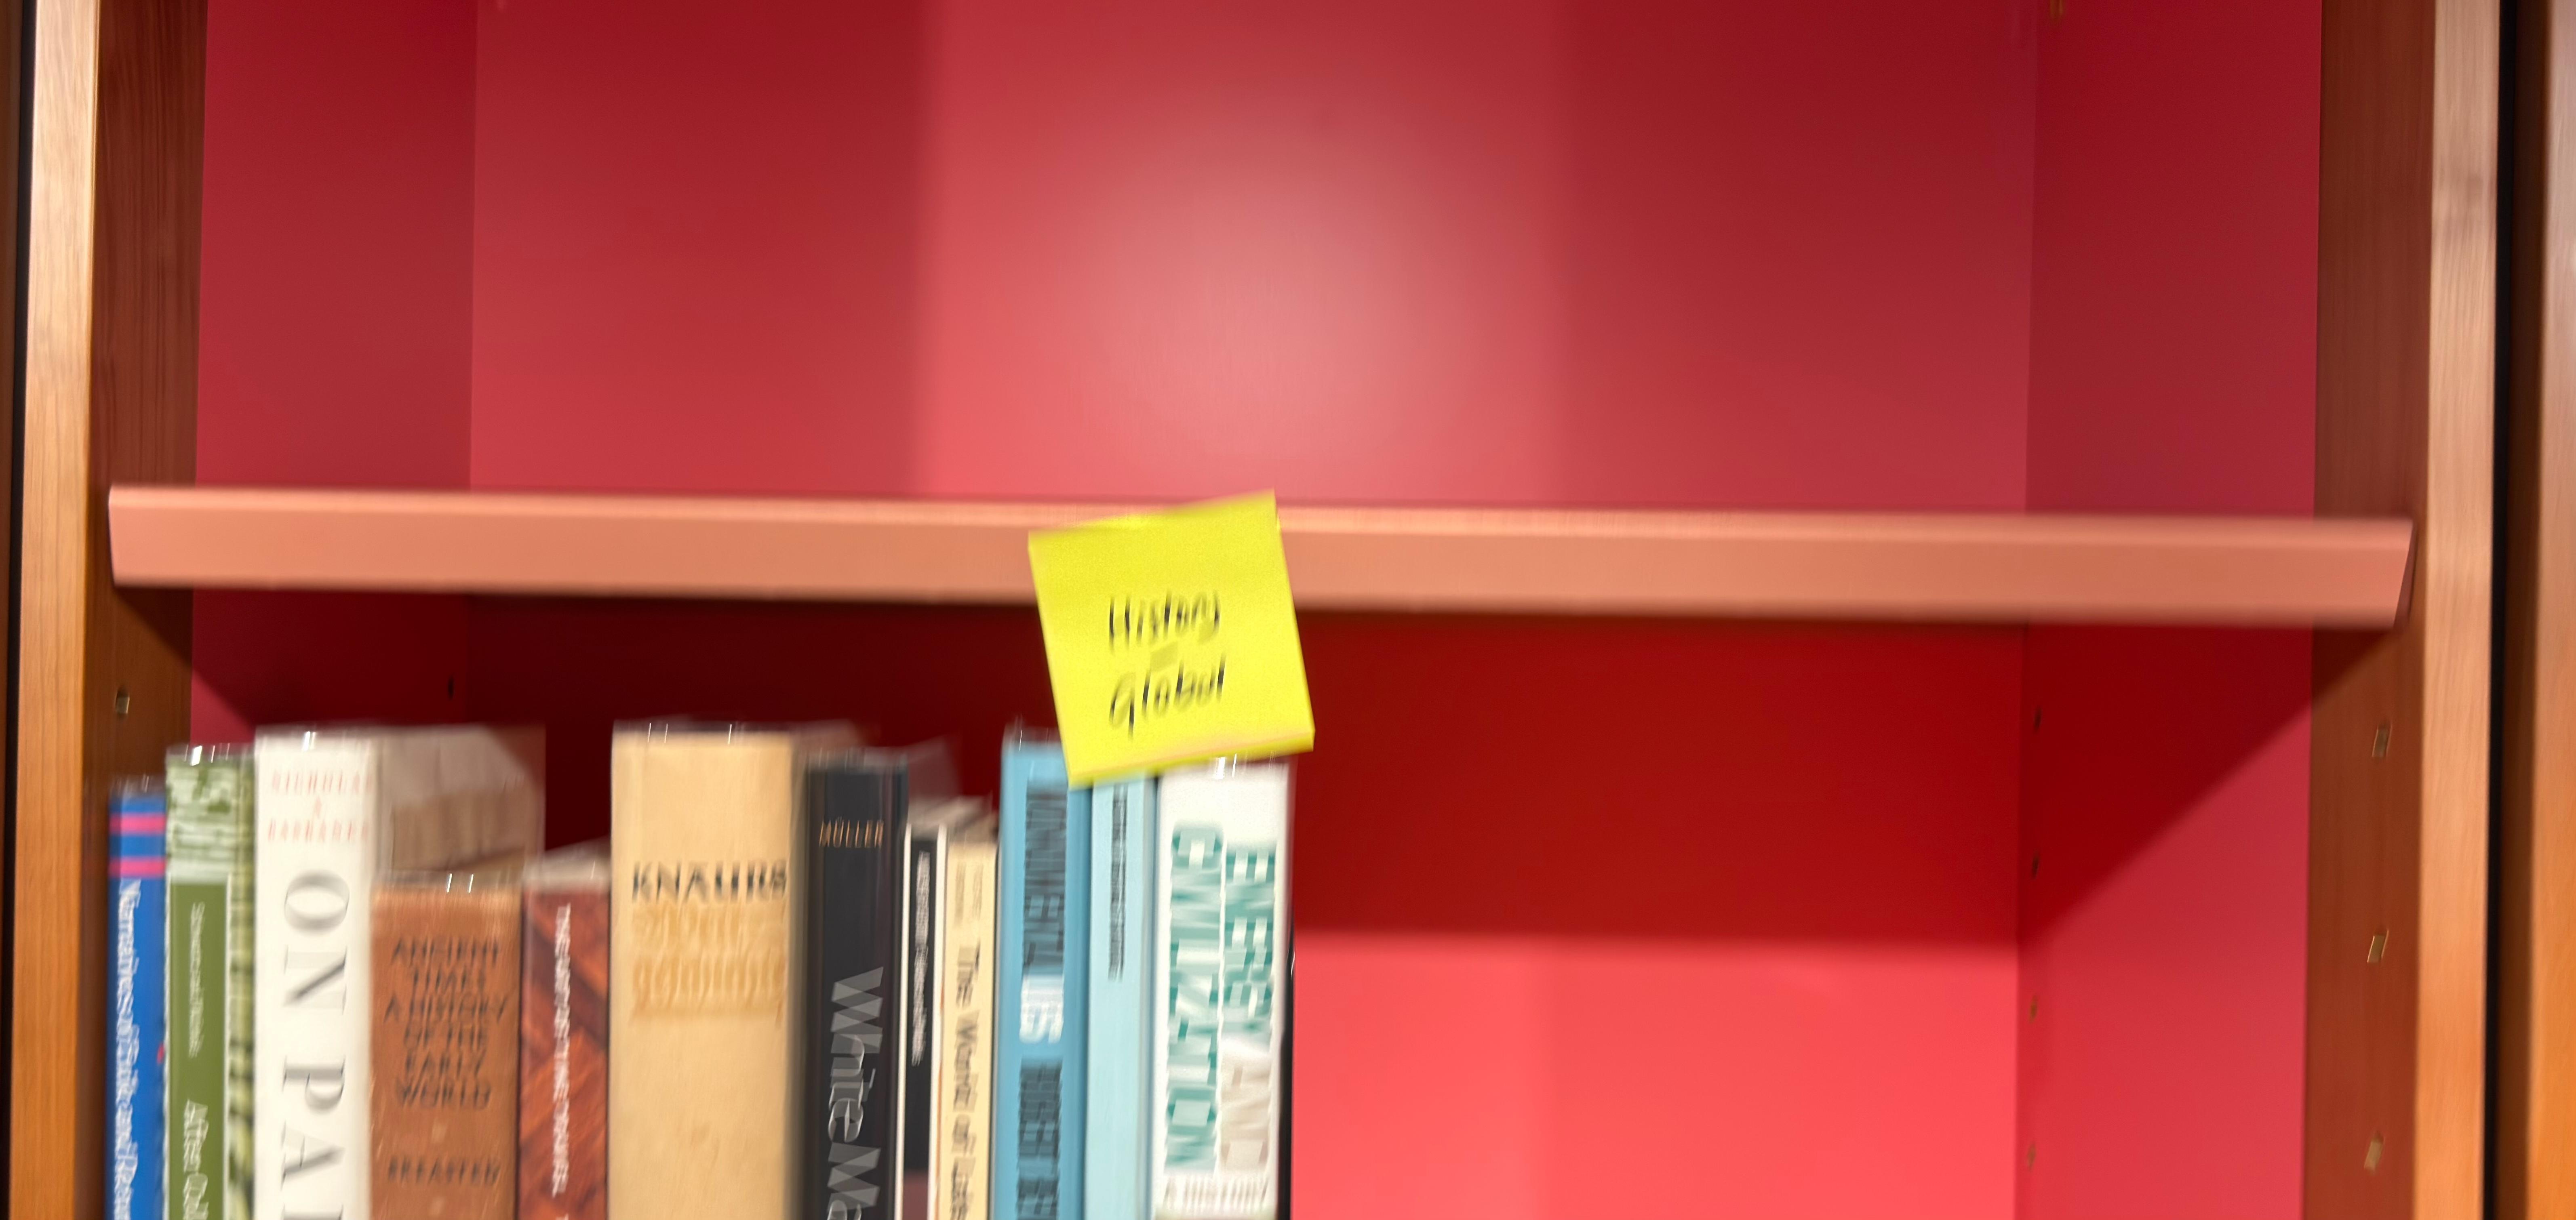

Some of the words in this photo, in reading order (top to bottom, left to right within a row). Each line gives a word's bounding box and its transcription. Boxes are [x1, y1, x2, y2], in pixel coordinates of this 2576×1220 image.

[1109, 591, 1221, 647] History
[1109, 655, 1226, 738] Global
[819, 818, 884, 848] MÜLLER
[632, 861, 787, 903] KNAURS
[283, 869, 351, 1013] ON
[390, 936, 501, 966] ANCIENT
[1224, 846, 1276, 1050] ENERGY
[406, 966, 487, 995] TIMES
[955, 944, 980, 1007] The
[1166, 827, 1222, 1172] CIVILIZATION
[383, 994, 402, 1023] A
[408, 994, 508, 1023] HISTORY
[403, 1022, 440, 1051] OF
[445, 1022, 489, 1051] THE
[1020, 974, 1064, 1043] LIES
[403, 1051, 485, 1080] EARLY
[828, 967, 883, 1142] White
[952, 1012, 979, 1112] World
[394, 1078, 492, 1109] WORLD
[1220, 1054, 1271, 1174] AND
[282, 1055, 346, 1220] PA
[951, 1115, 976, 1155] of
